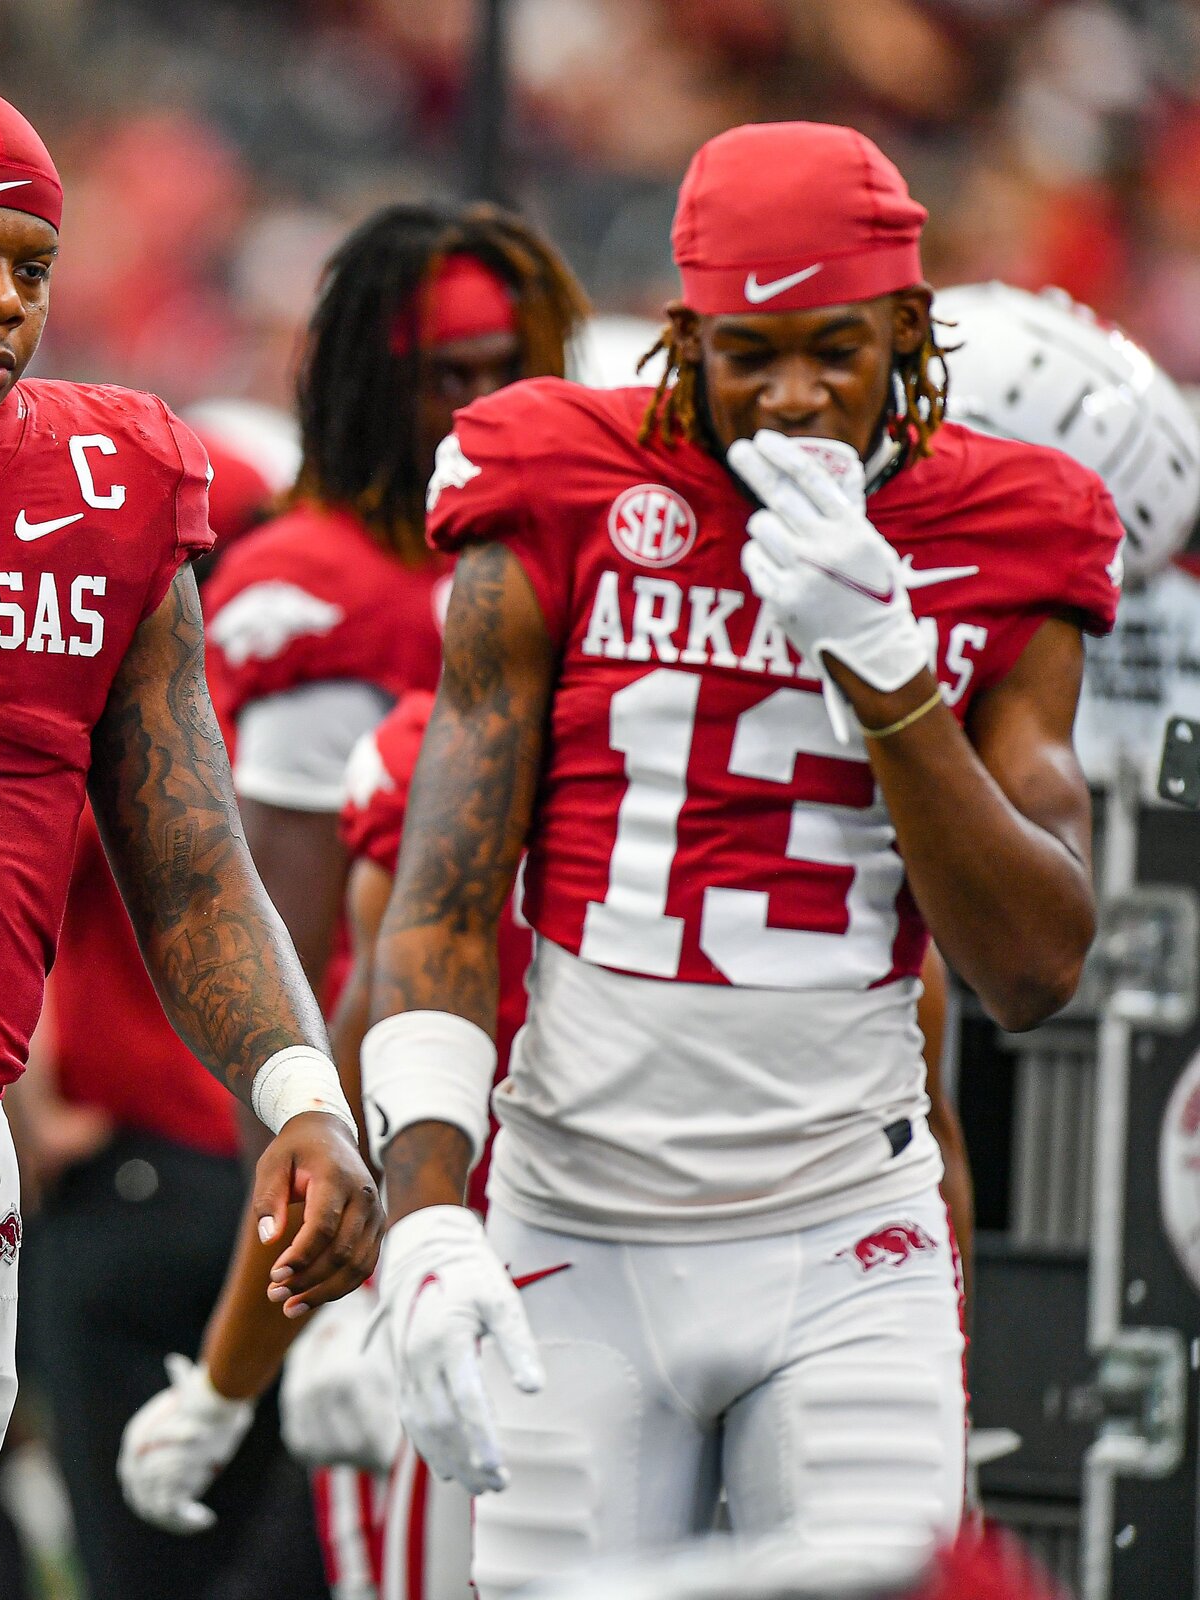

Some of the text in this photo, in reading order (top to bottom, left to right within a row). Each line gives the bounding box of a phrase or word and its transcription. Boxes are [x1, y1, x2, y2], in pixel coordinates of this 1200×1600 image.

[67, 434, 125, 509] C
[619, 491, 688, 560] SEC
[582, 570, 988, 706] ARKAS
[579, 669, 905, 989] 13
